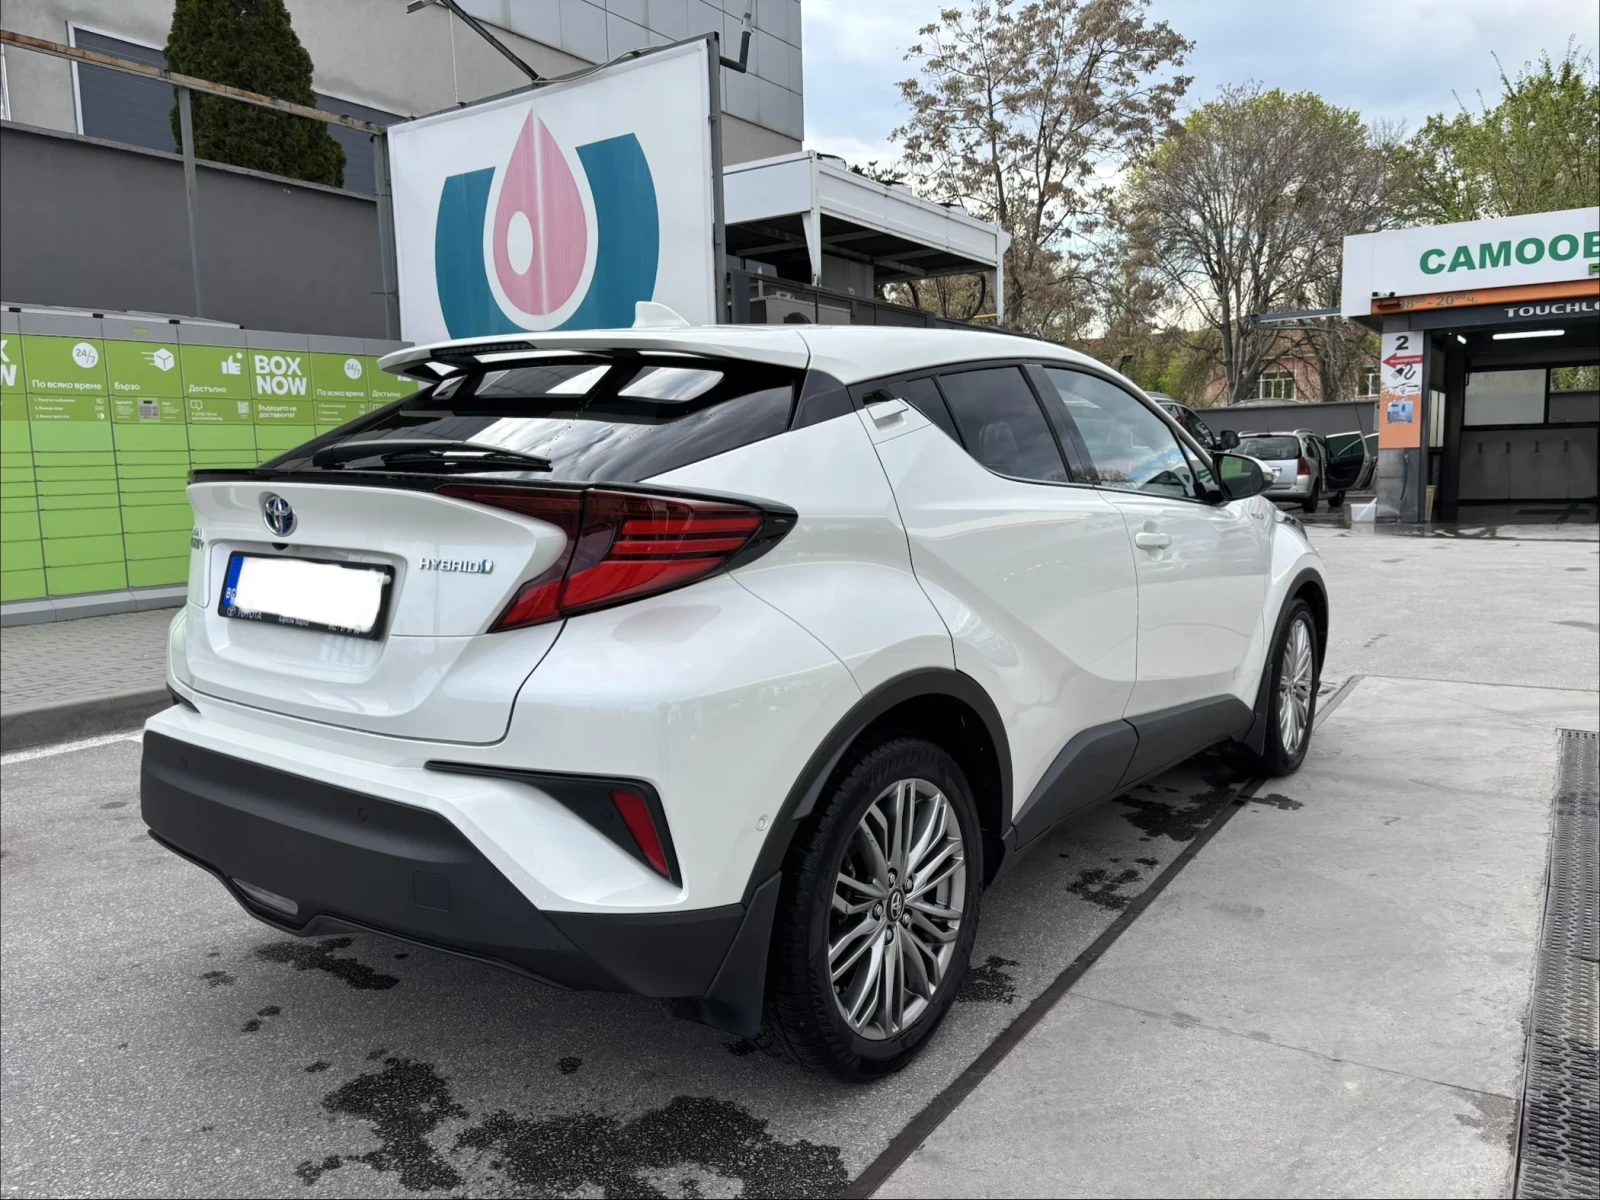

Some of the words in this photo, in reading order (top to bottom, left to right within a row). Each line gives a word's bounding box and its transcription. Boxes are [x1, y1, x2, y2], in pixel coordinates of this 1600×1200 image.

[1395, 335, 1409, 351] 2
[75, 348, 96, 364] 24/7
[254, 354, 303, 376] BOX
[346, 363, 360, 376] 24/7
[32, 379, 46, 389] По
[47, 381, 73, 390] всяко
[75, 382, 102, 391] време
[114, 382, 140, 392] Бързо
[188, 384, 227, 394] Достъпно
[256, 375, 307, 396] NOW
[346, 391, 364, 399] време
[372, 390, 401, 398] Достъпно
[420, 558, 481, 573] HYBRID
[225, 587, 236, 600] BG
